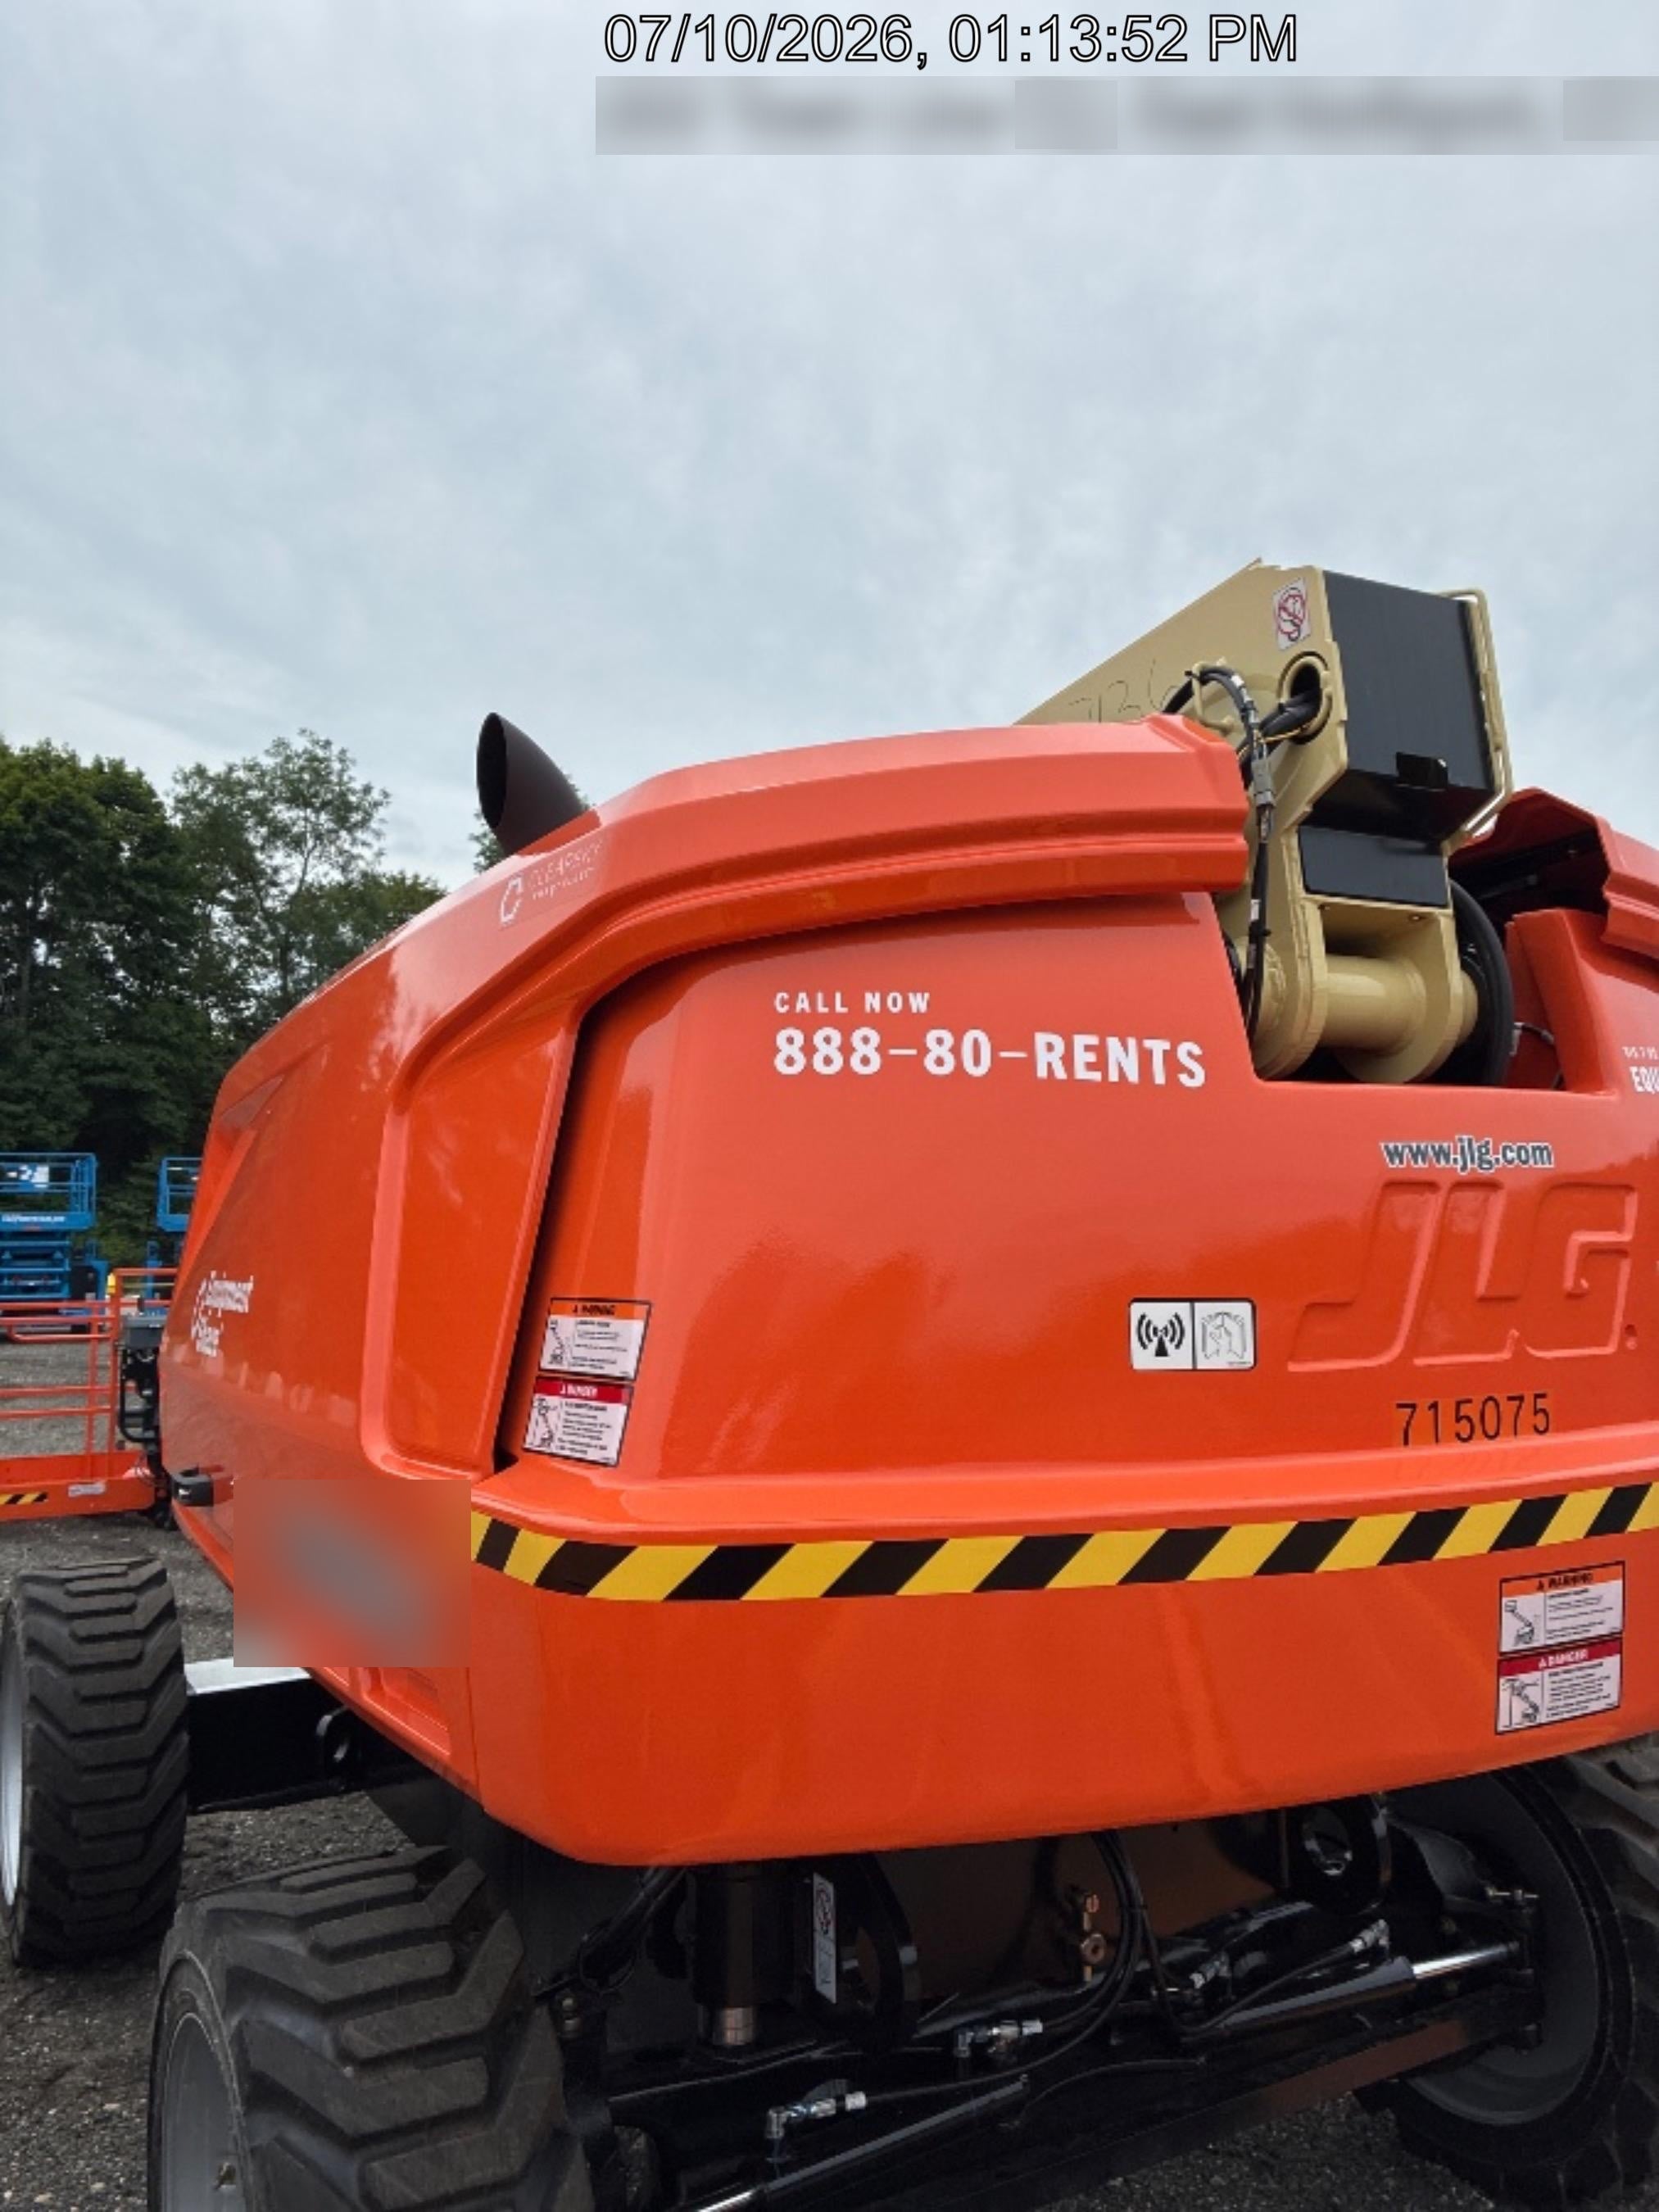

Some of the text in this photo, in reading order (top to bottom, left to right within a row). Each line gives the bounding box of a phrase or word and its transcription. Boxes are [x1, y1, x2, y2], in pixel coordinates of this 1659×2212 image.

[773, 990, 931, 1014] CALL NOW
[773, 1026, 1207, 1089] 888-80-RENTS
[1379, 1135, 1555, 1175] www.jlg.com
[1394, 1392, 1551, 1447] 715075
